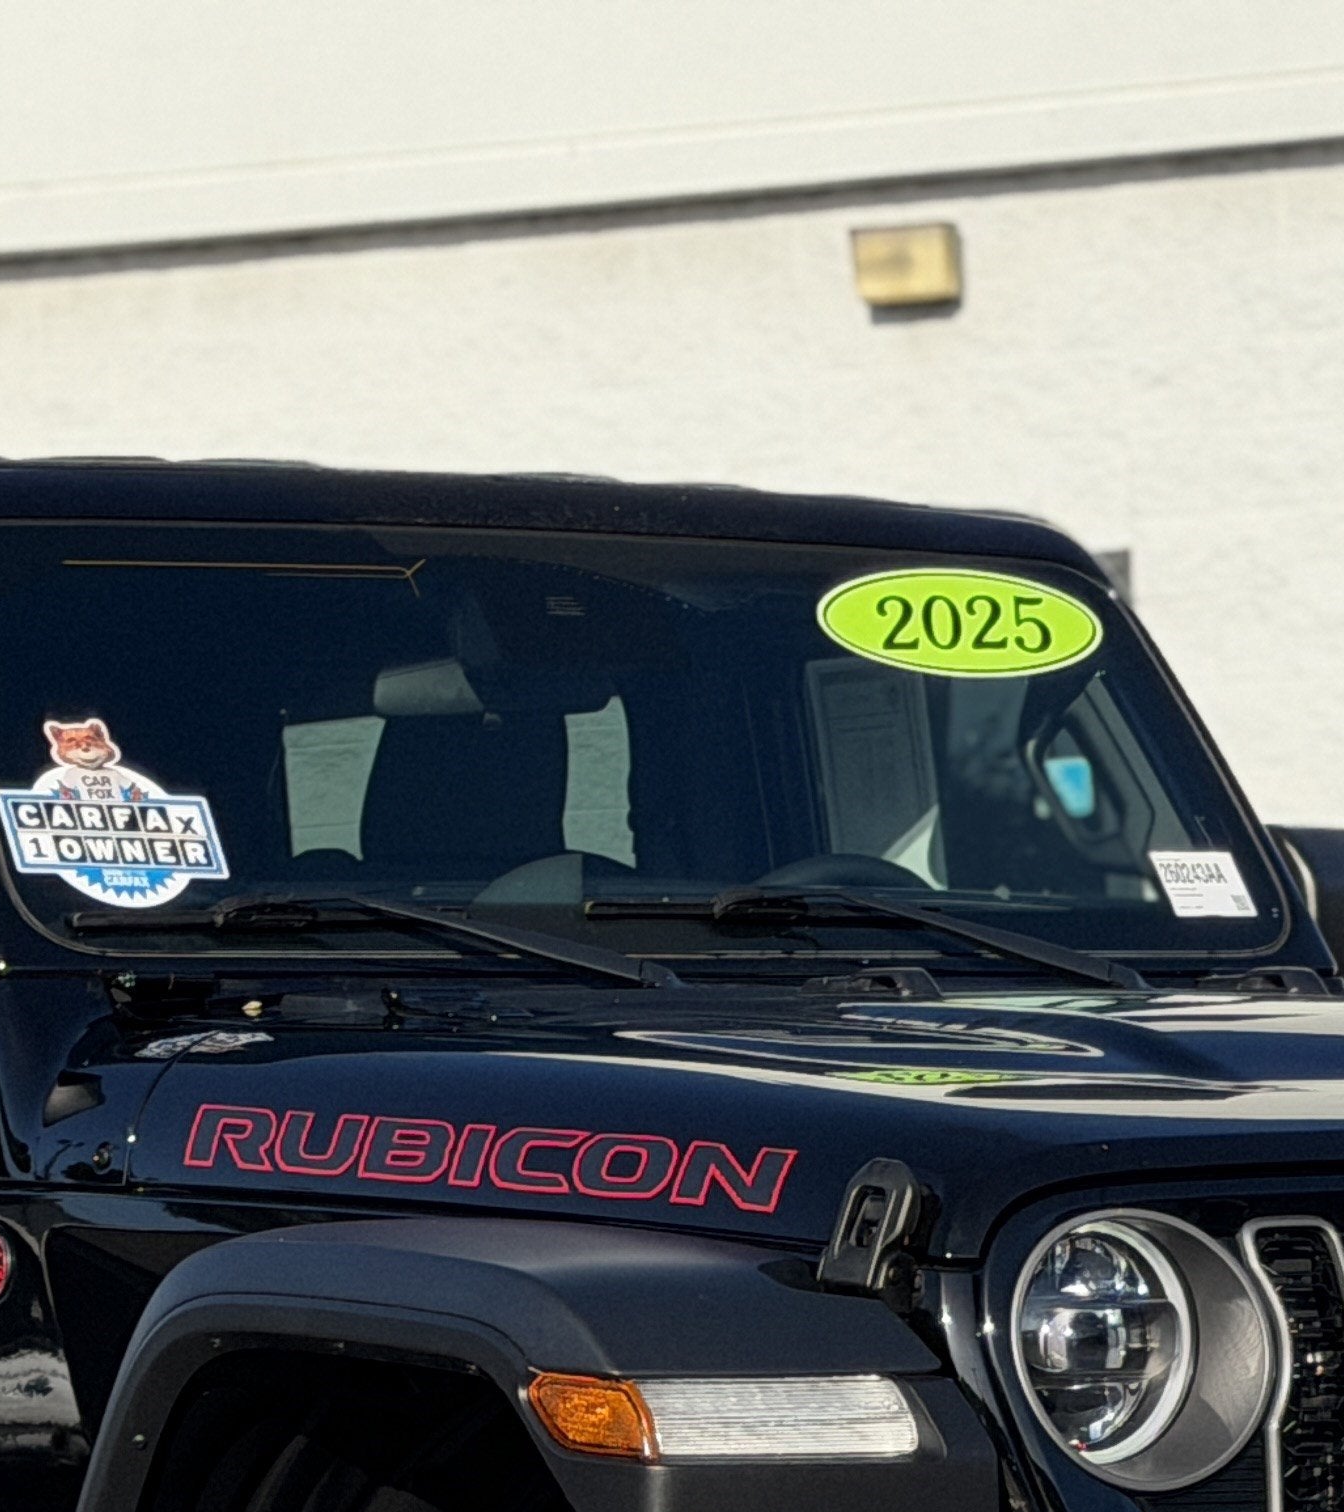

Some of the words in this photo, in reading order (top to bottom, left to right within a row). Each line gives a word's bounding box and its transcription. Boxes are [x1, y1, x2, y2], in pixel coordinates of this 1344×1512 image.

[875, 594, 1052, 654] 2025
[81, 775, 111, 787] CAR
[87, 788, 116, 800] FOX
[17, 804, 198, 835] CARFAX
[183, 1103, 798, 1214] RUBICON
